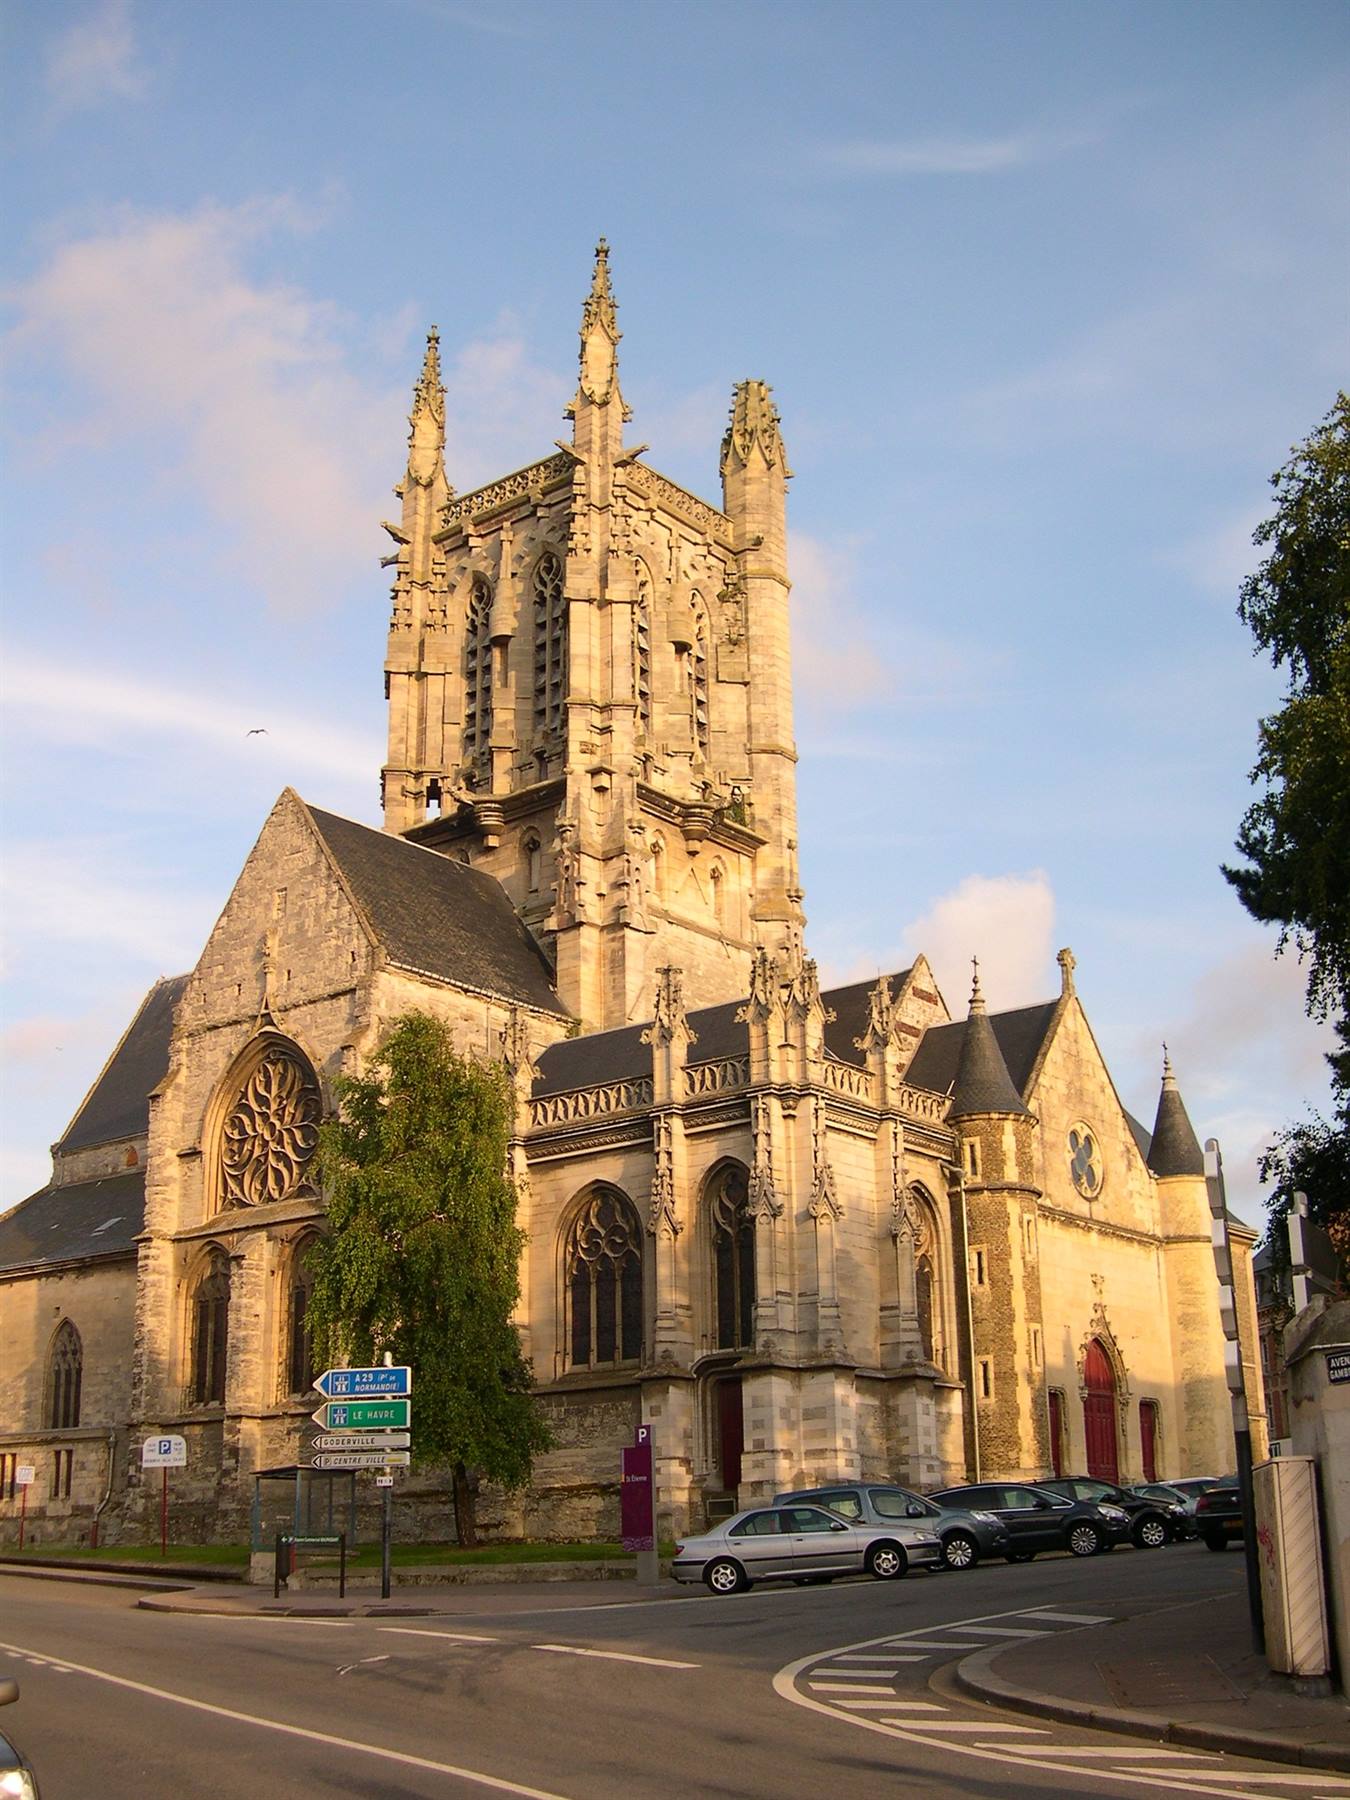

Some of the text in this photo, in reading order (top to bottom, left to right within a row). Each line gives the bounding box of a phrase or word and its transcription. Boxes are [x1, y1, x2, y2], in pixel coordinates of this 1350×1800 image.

[353, 1410, 395, 1420] LE HAVRE
[639, 1428, 648, 1443] P
[323, 1437, 375, 1446] GODERVILLE
